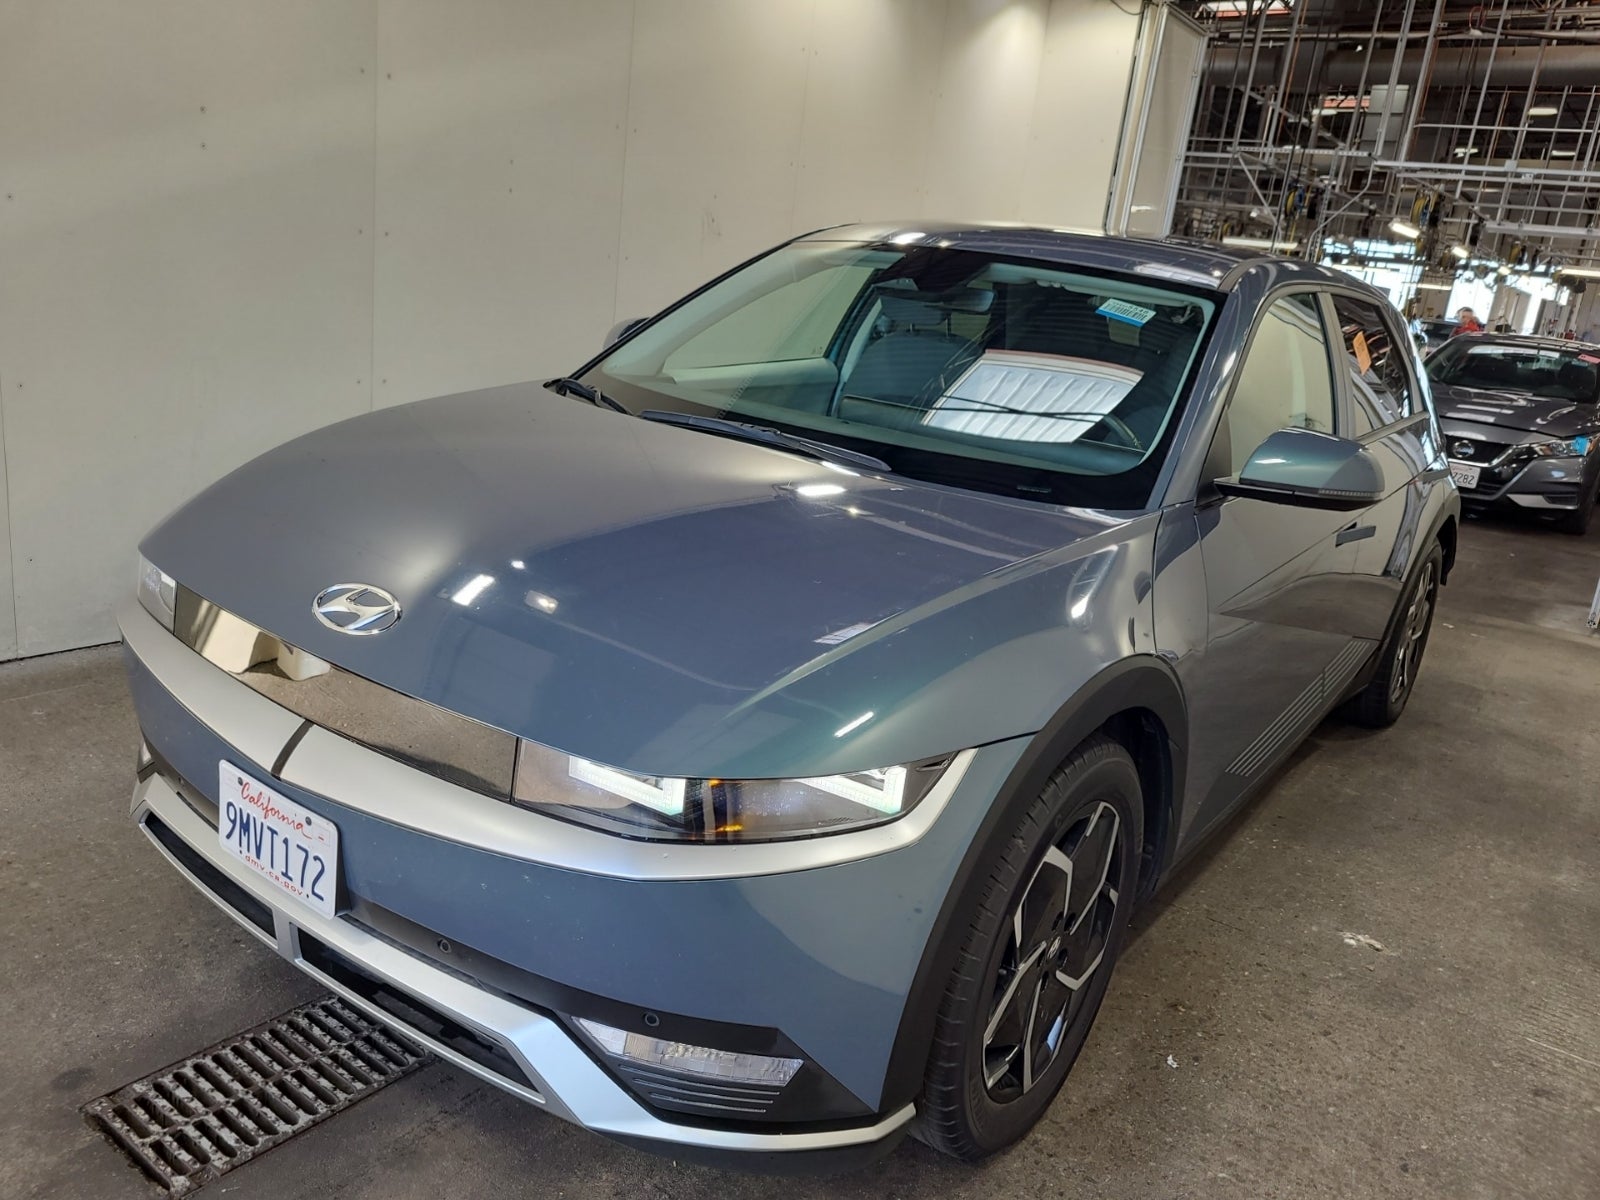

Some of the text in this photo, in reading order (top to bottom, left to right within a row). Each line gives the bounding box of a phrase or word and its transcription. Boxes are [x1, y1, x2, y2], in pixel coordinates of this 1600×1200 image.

[241, 782, 312, 839] California
[226, 801, 324, 901] 9MVT172
[245, 855, 303, 896] dmv.ca.gov
